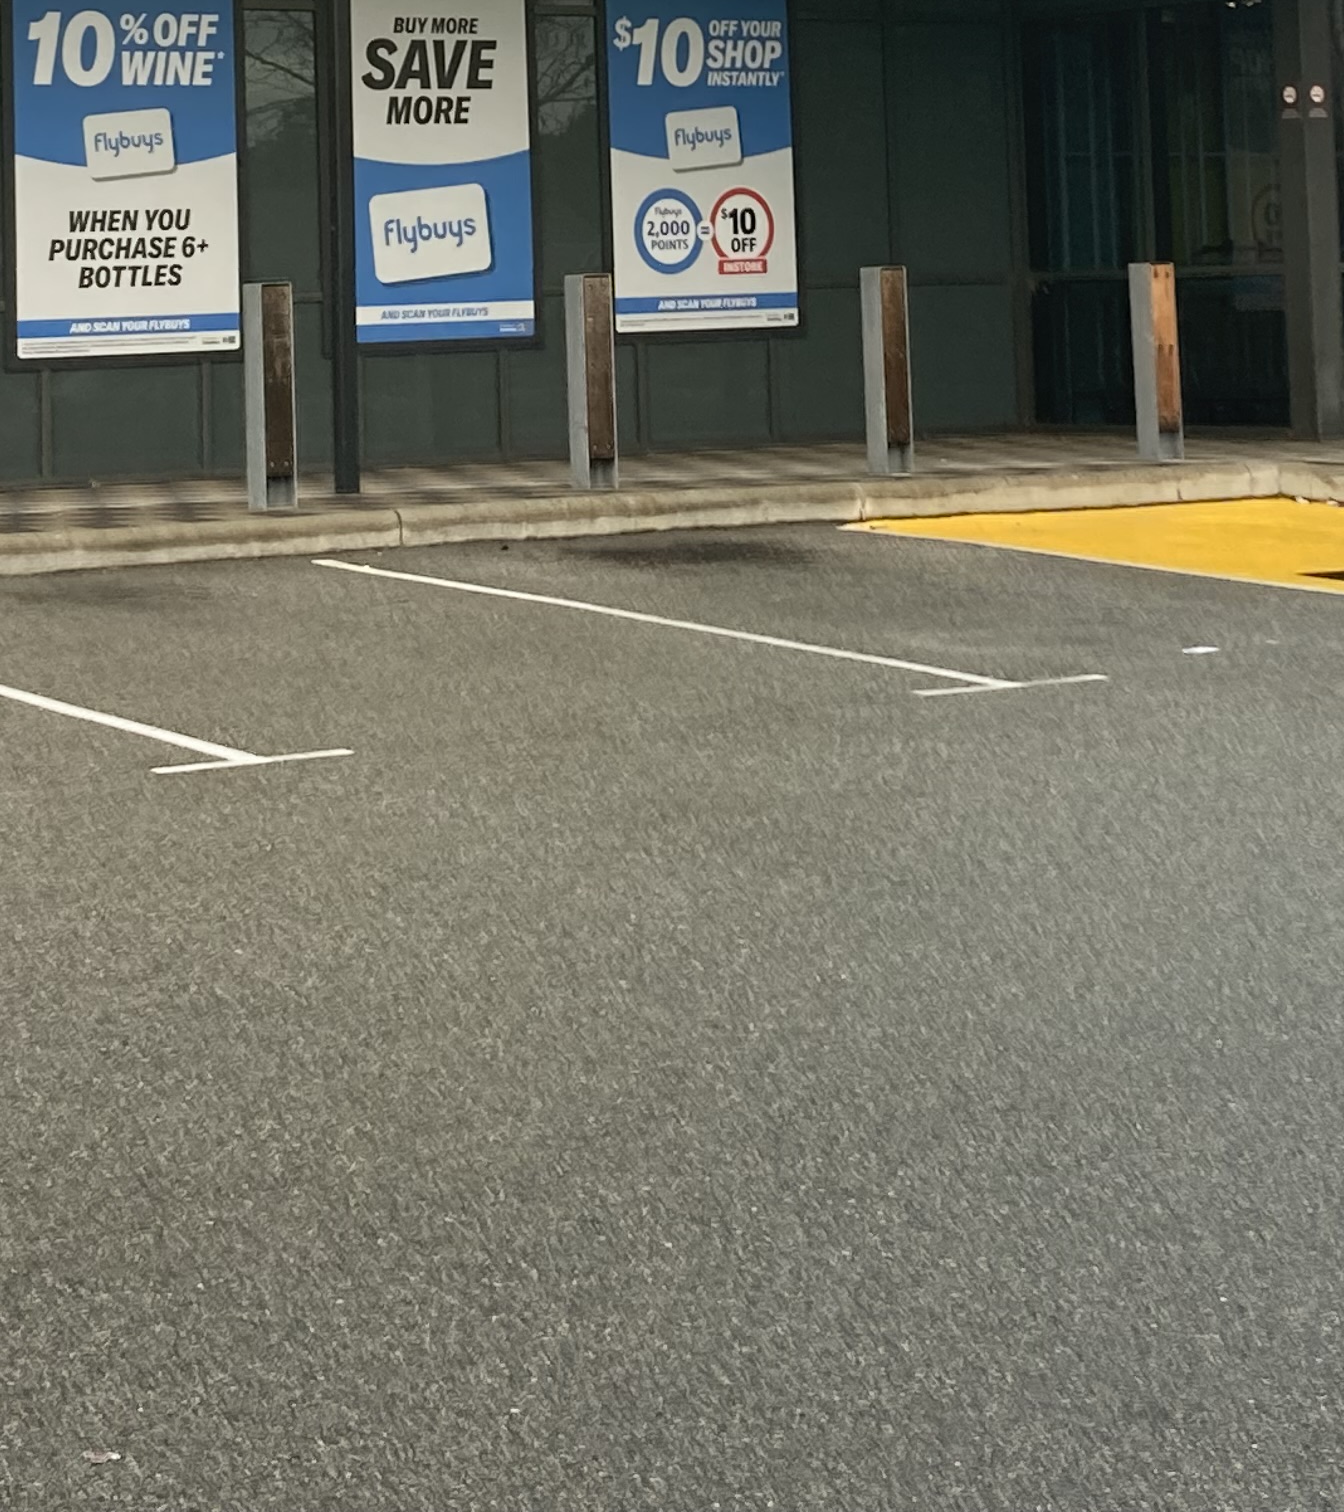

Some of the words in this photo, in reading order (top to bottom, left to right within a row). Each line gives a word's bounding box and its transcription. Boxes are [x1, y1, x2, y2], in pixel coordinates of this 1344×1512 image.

[393, 17, 428, 34] BUY
[431, 17, 479, 34] MORE
[709, 20, 739, 37] OFF
[740, 20, 782, 37] YOUR
[361, 38, 497, 91] SAVE
[706, 39, 783, 70] SHOP
[386, 95, 471, 125] MORE
[69, 209, 139, 233] WHEN
[145, 208, 191, 231] YOU
[647, 220, 691, 238] 2,000
[48, 236, 178, 261] PURCHASE
[182, 236, 209, 258] 6+
[651, 239, 689, 251] POINTS
[730, 238, 757, 253] OFF
[78, 264, 183, 289] BOTTLES
[69, 322, 92, 334] AND
[93, 321, 120, 333] SCAN
[121, 320, 148, 332] YOUR
